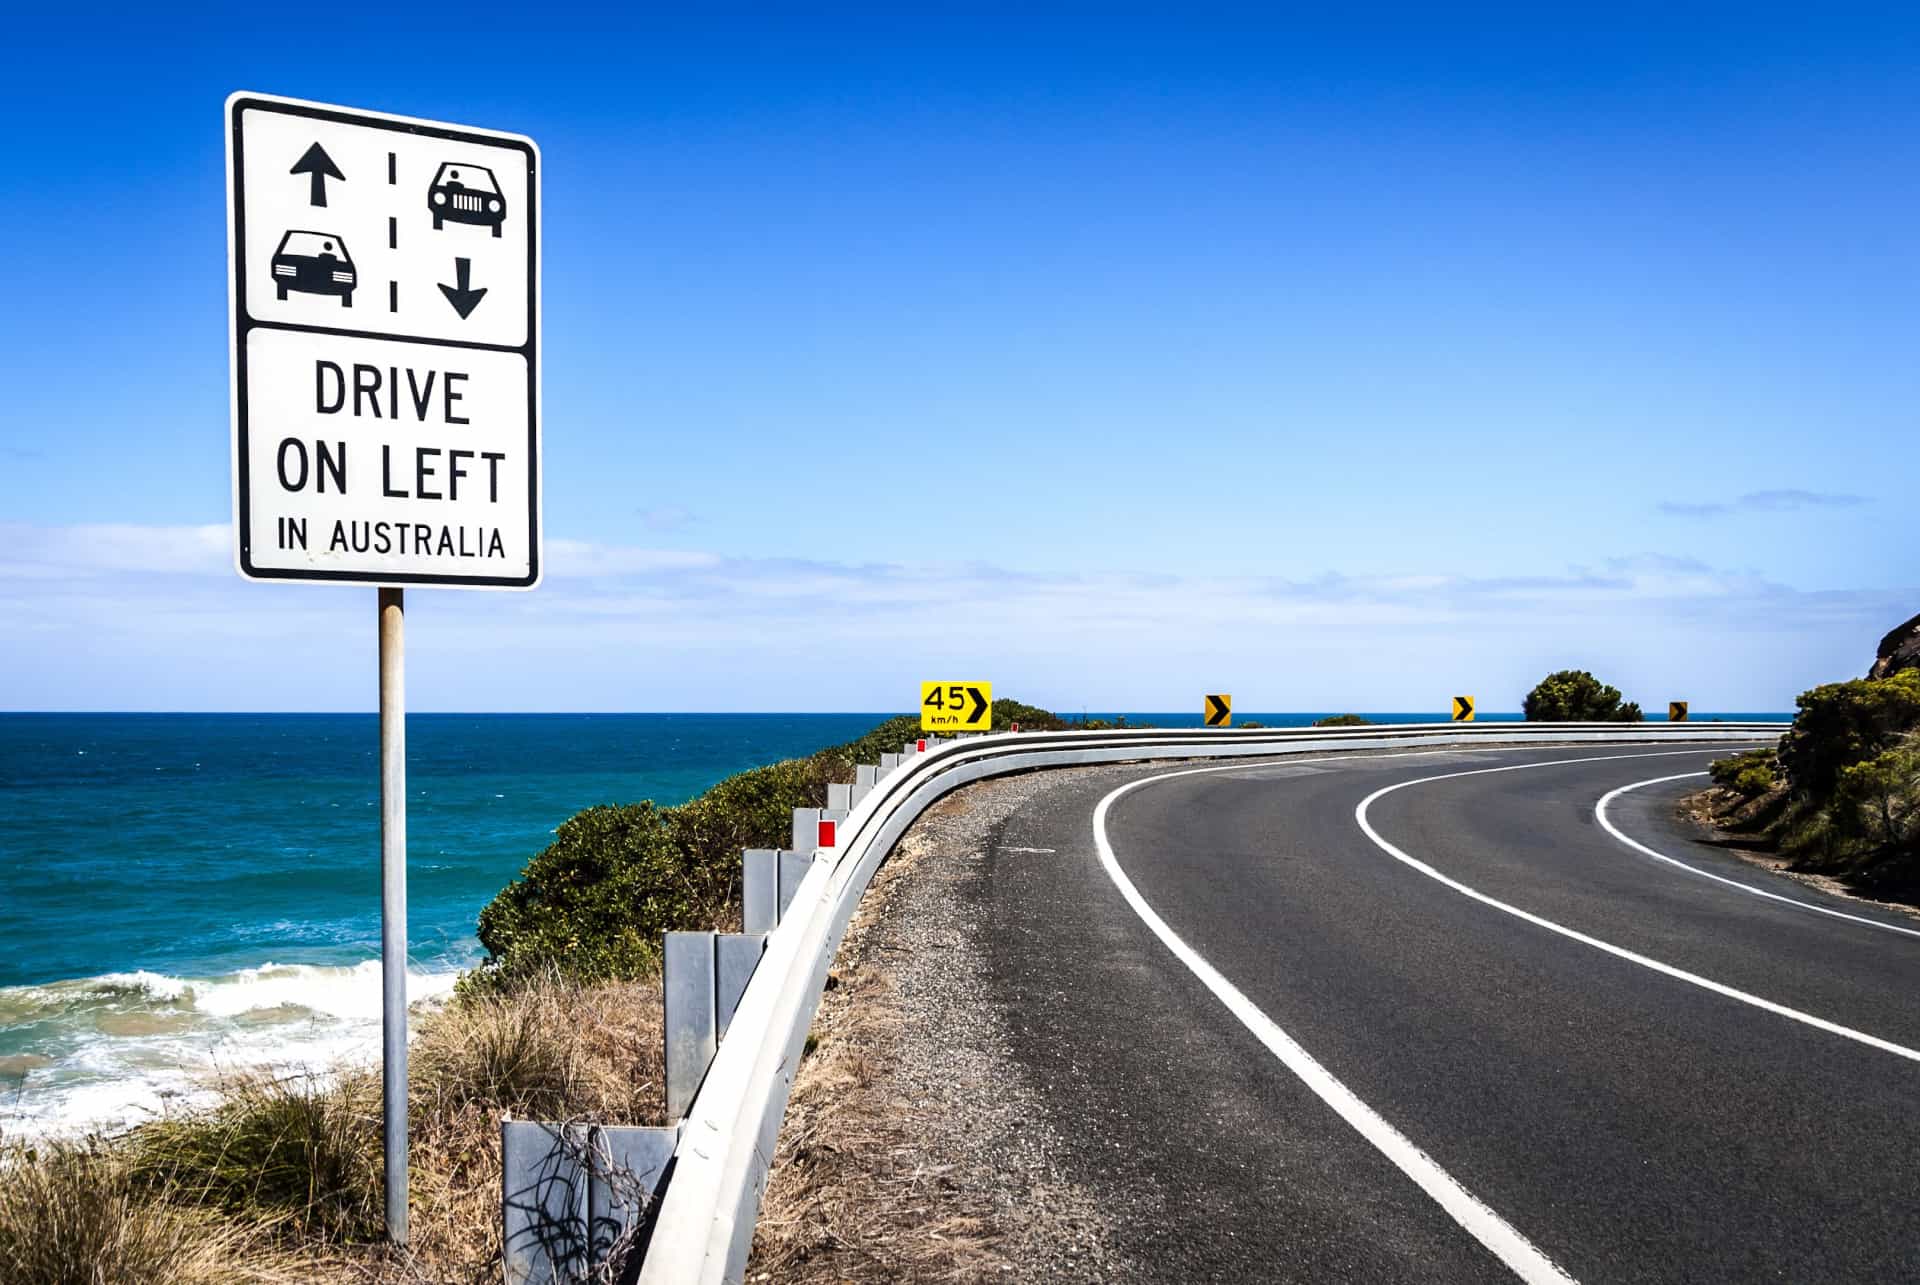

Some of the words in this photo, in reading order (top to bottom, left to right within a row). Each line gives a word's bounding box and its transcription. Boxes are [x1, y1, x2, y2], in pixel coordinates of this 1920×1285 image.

[316, 359, 470, 425] DRIVE
[277, 437, 347, 495] ON
[382, 444, 506, 503] LEFT
[278, 517, 307, 550] IN
[329, 519, 505, 559] AUSTRALIA
[924, 686, 965, 711] 45
[930, 714, 959, 724] km/h
